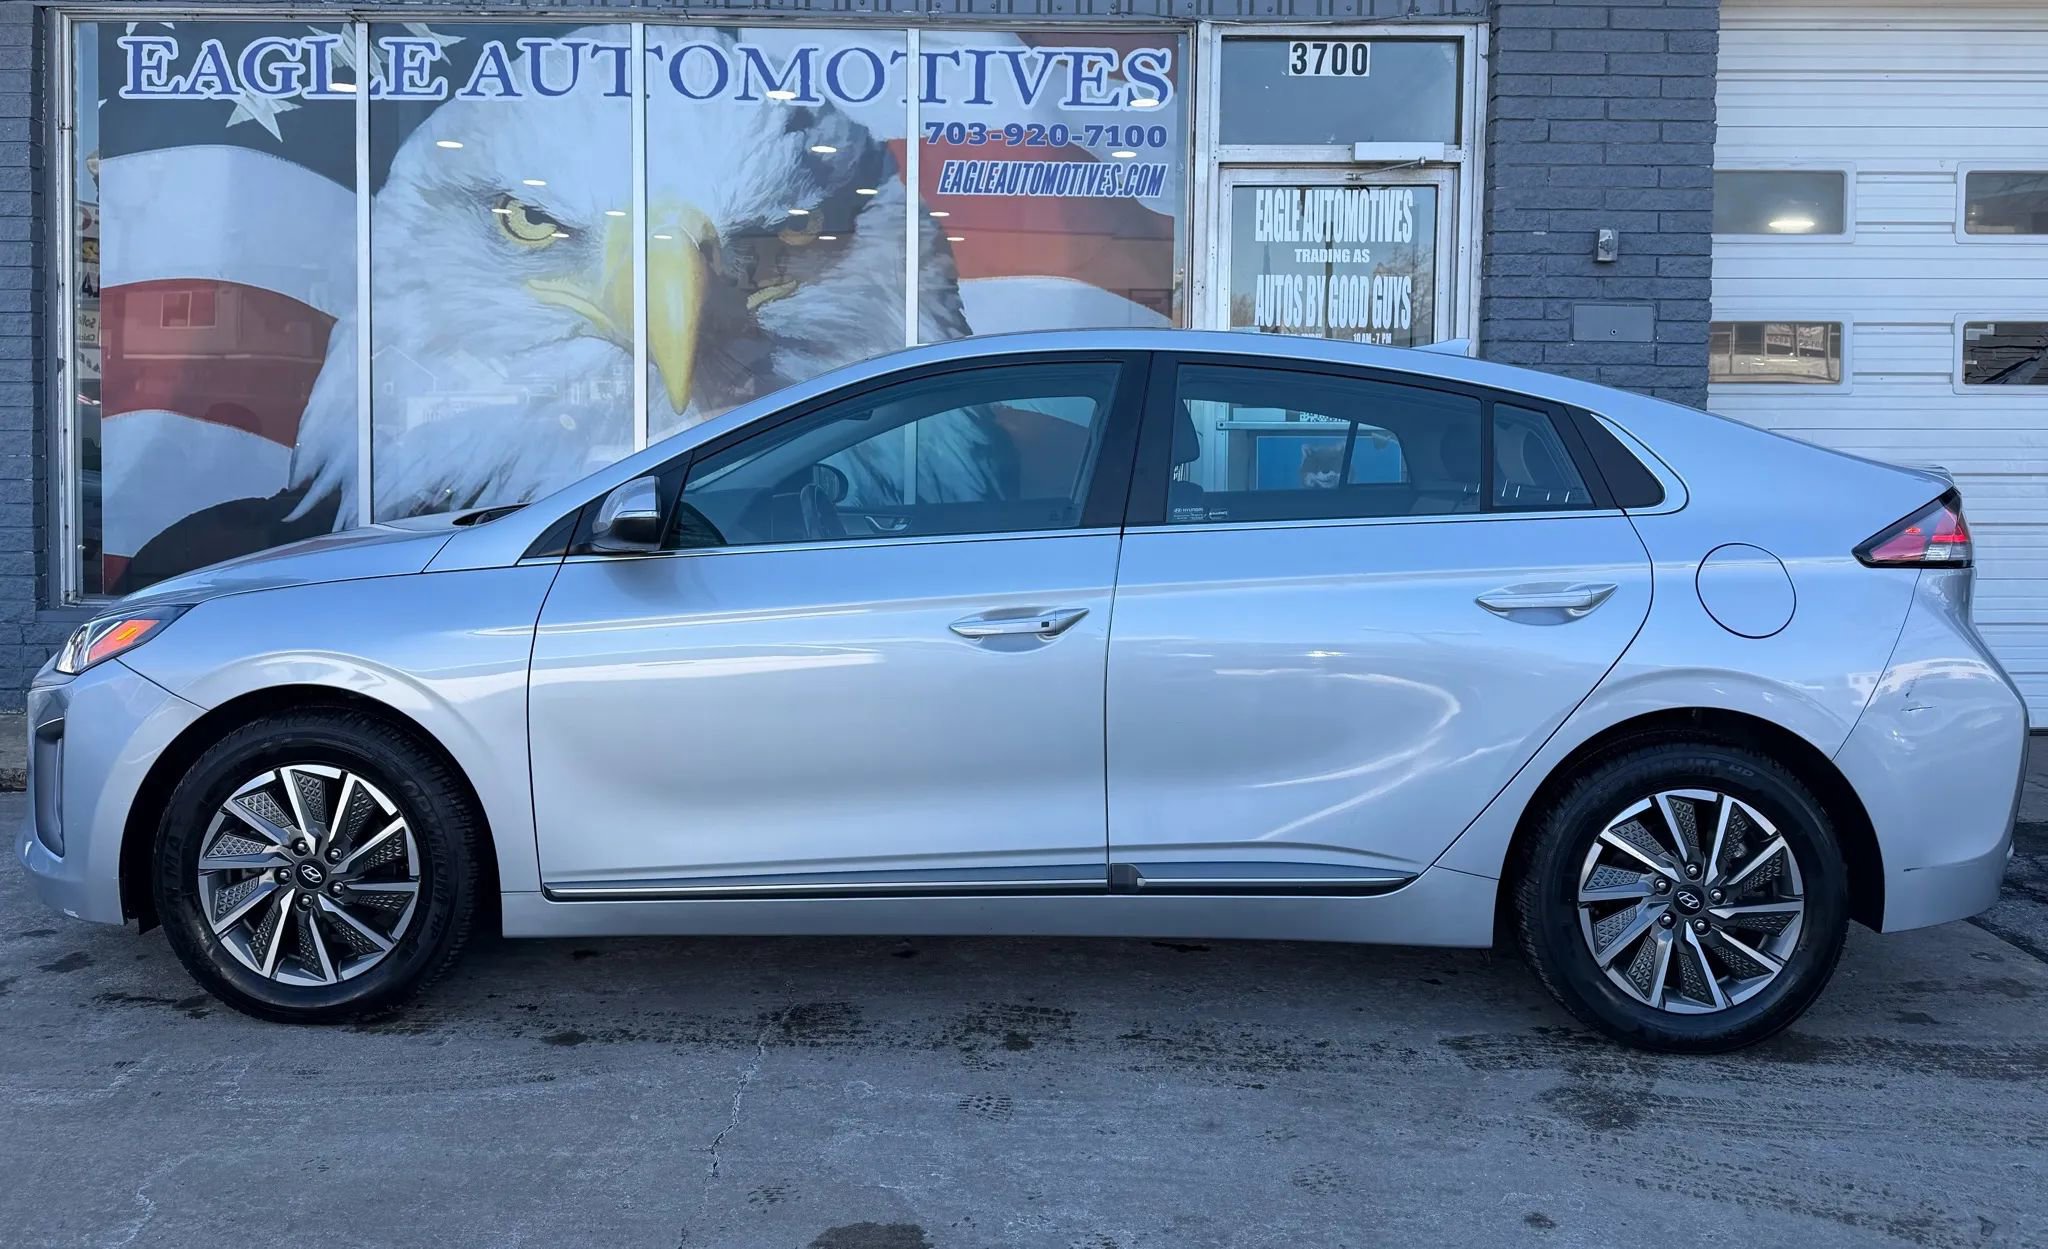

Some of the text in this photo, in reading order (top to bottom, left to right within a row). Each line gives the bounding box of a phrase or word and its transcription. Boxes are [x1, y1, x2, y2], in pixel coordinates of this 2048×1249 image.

[118, 35, 1173, 110] EAGLE AUTOMOTIVES
[1291, 42, 1369, 75] 3700
[925, 122, 1167, 149] 703-920-7100
[938, 161, 1168, 197] EAGLEAUTOMOTIVES.COM
[1255, 189, 1414, 243] EAGLE AUTOMOTIVES
[1295, 249, 1370, 263] TRADING AS
[1254, 274, 1411, 330] AUTOS BY GOOD GUYS
[1353, 333, 1361, 343] 10
[1362, 333, 1371, 344] AM
[1376, 333, 1380, 344] 7
[1382, 333, 1392, 345] PM
